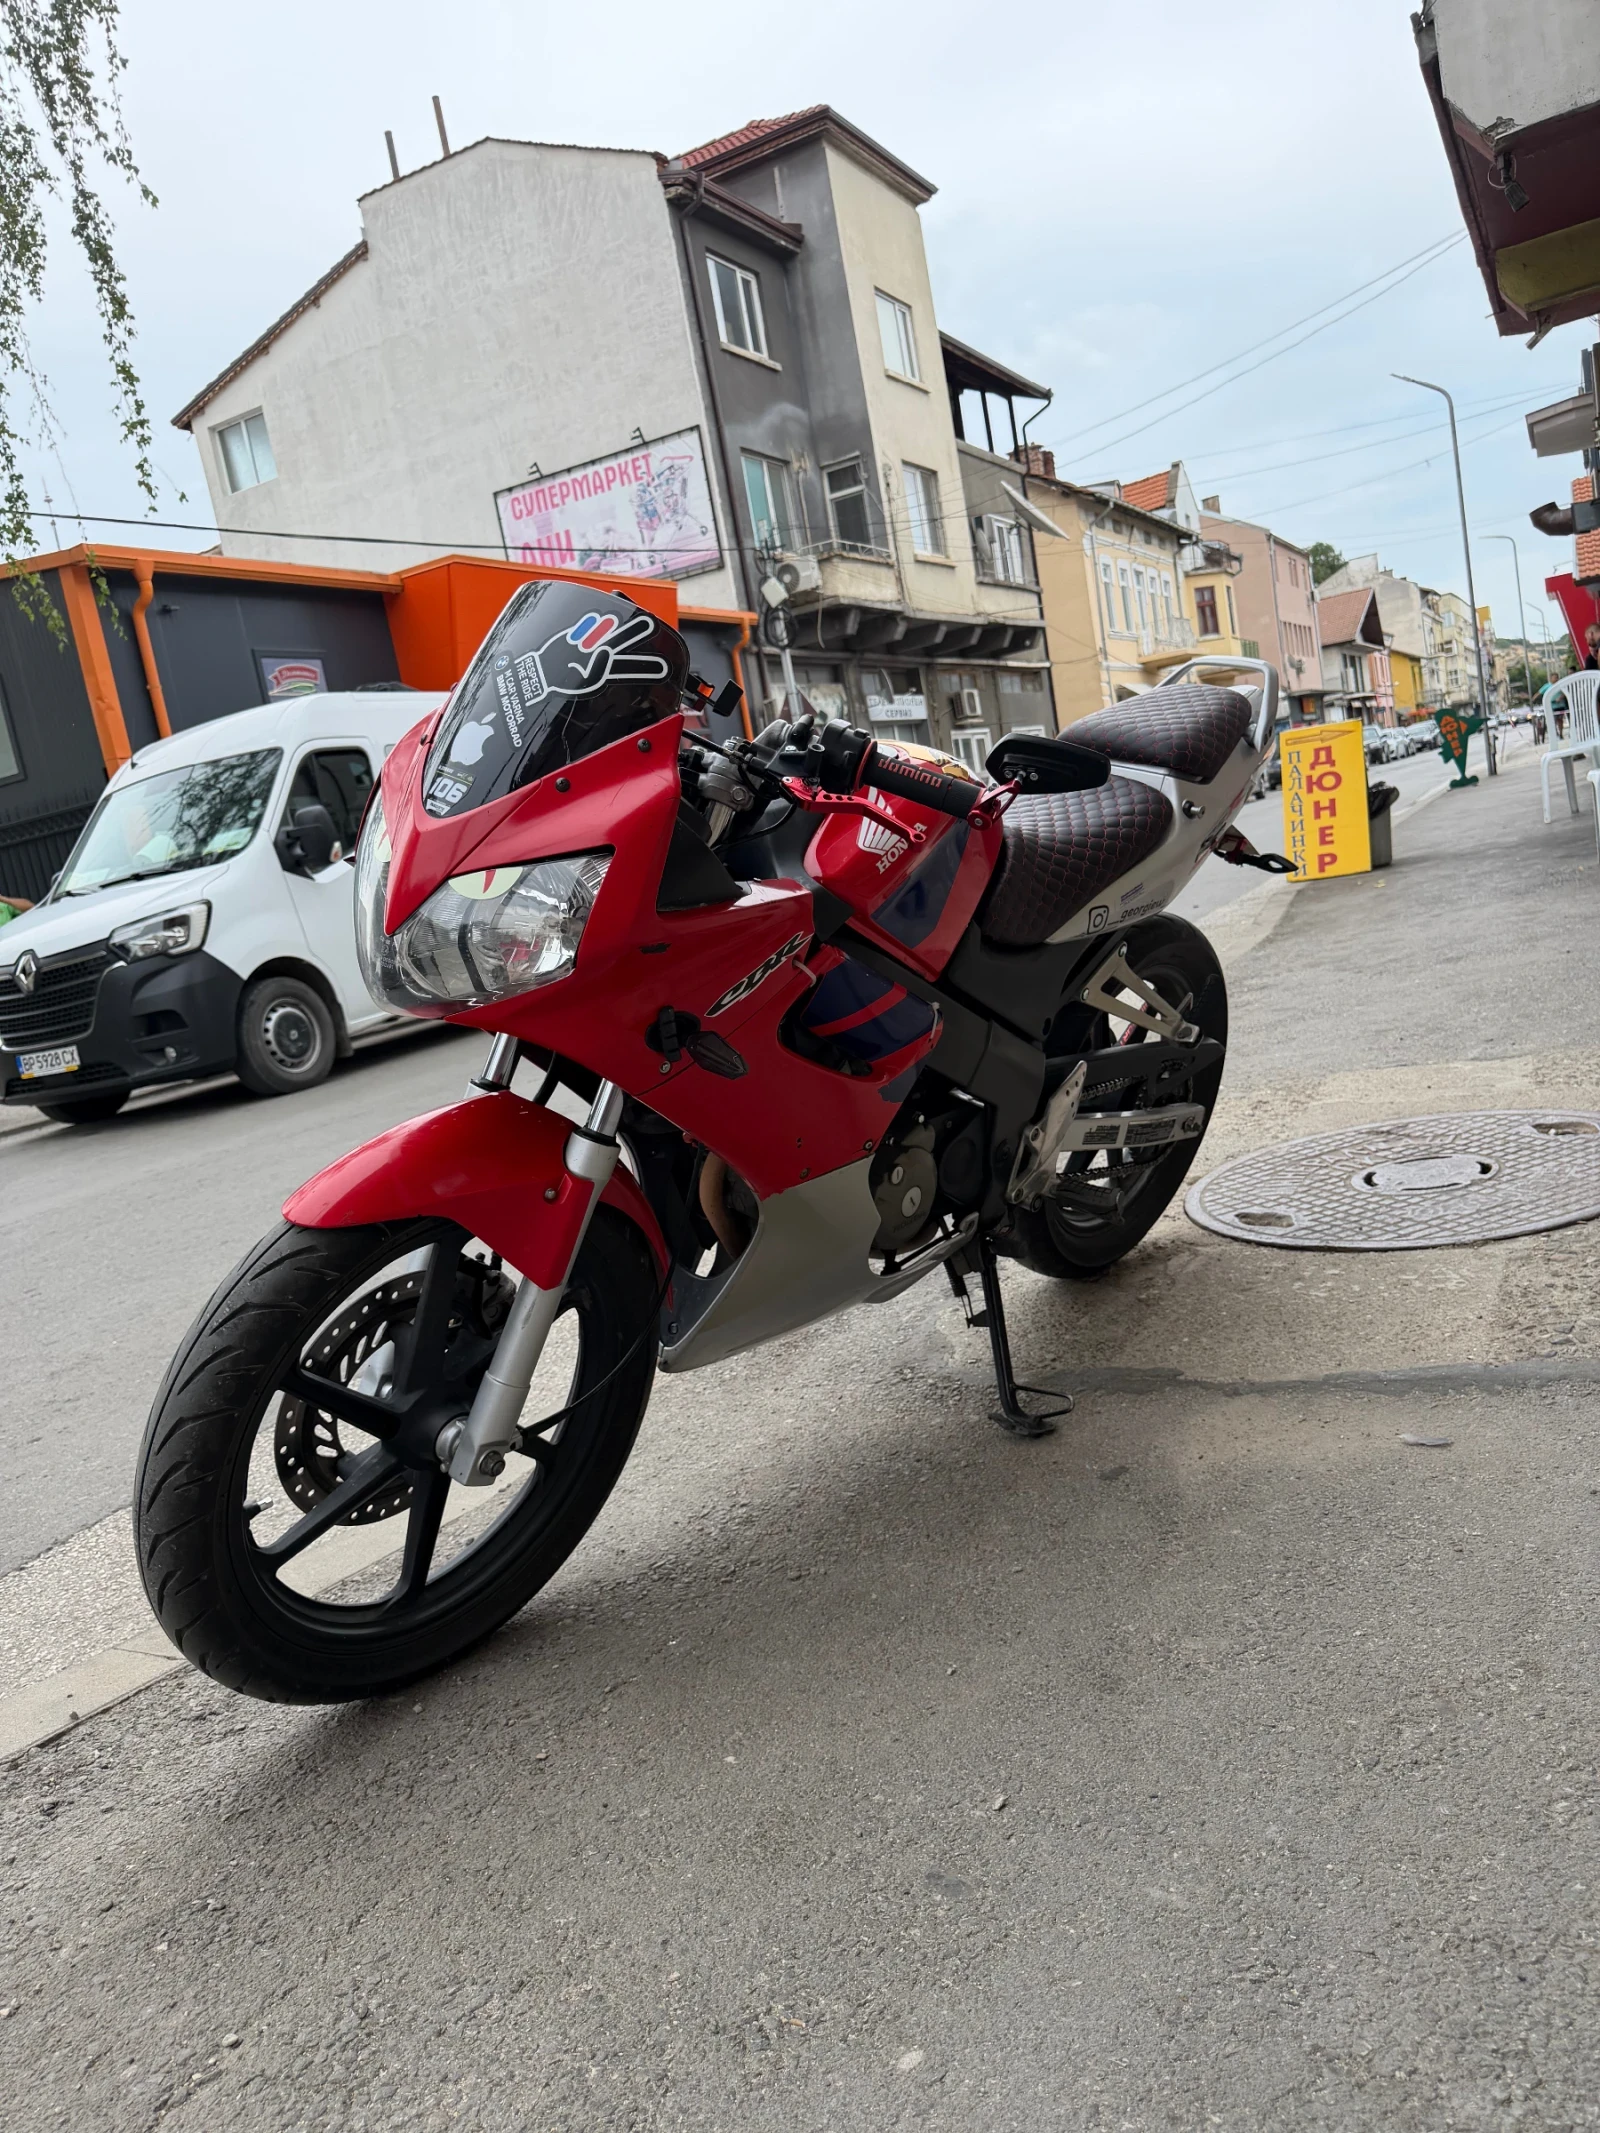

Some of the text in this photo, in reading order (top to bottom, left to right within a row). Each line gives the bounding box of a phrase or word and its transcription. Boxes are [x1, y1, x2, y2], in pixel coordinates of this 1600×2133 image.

[510, 453, 652, 521] СУПЕРМАРКЕТ
[505, 677, 516, 696] CAR
[516, 660, 533, 701] THE RIDE
[525, 656, 542, 698] RESPECT
[496, 674, 522, 748] BMW MOTORRAD
[510, 693, 525, 725] VARNA
[429, 776, 468, 804] 106
[1305, 745, 1342, 873] ДЮНЕР
[1287, 750, 1308, 878] ПАЛАЧИНКИ
[876, 823, 927, 874] HONA
[36, 1052, 62, 1069] 5928
